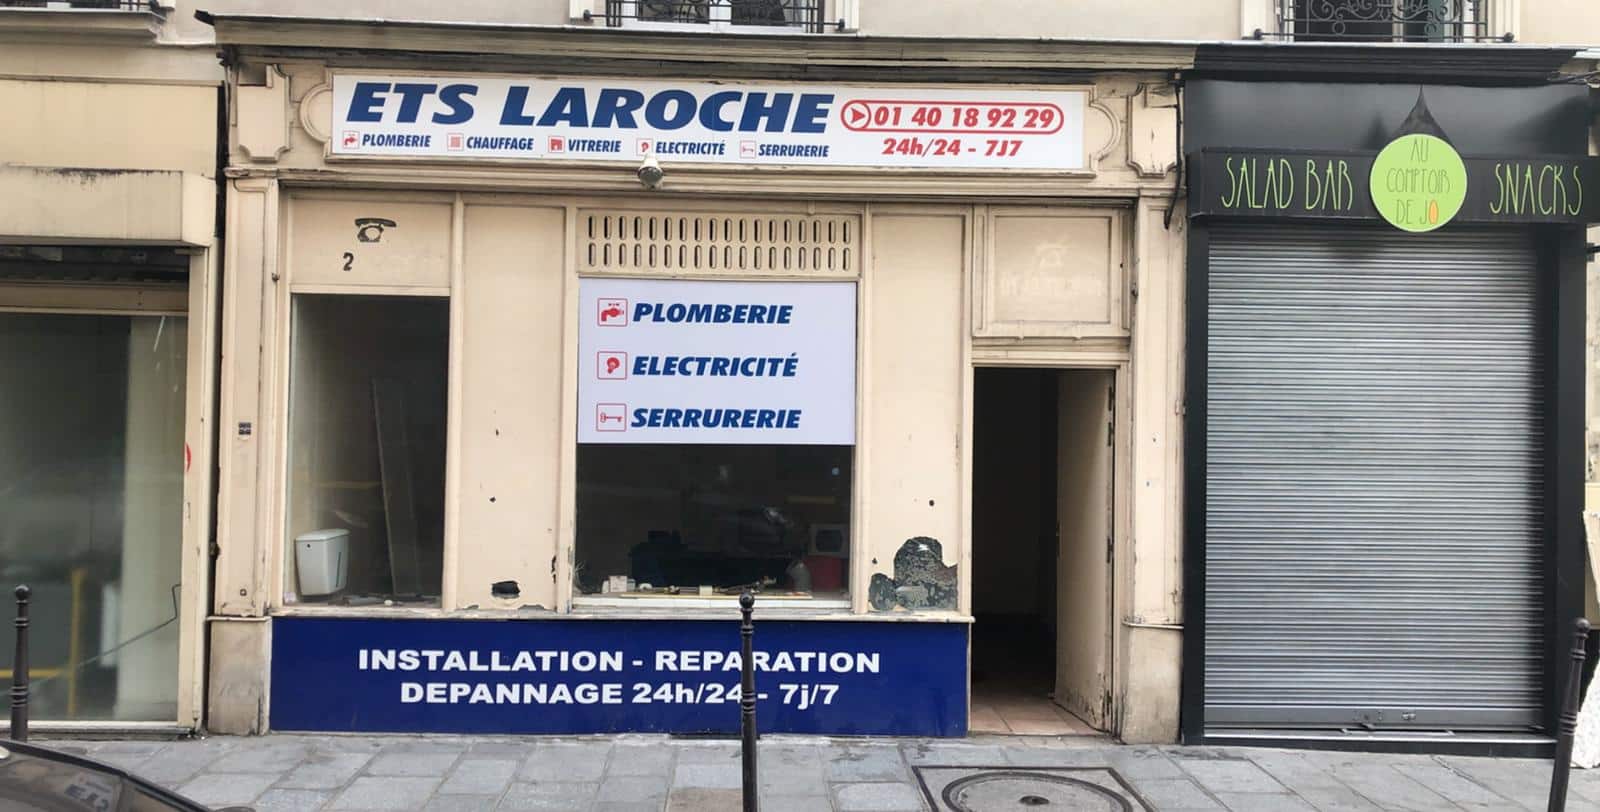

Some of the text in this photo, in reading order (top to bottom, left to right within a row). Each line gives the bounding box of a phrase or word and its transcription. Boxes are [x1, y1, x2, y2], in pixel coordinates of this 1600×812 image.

[346, 82, 835, 133] ETS LAROCHE
[874, 107, 1054, 128] 01 40 18 92 29
[362, 133, 432, 148] PLOMBERIE
[466, 136, 534, 151] CHAUFFAGE
[568, 139, 621, 153] VITRERIE
[655, 139, 726, 155] ELECTRICITÉ
[758, 144, 829, 158] SERRURERIE
[882, 138, 961, 157] 24h/24
[986, 140, 1023, 157] 7J7
[1410, 137, 1429, 162] AU
[1222, 158, 1353, 211] SALAD BAR
[1386, 167, 1451, 194] COMPTOIR
[1489, 163, 1583, 217] SNACKS
[1396, 199, 1439, 225] DE JO
[343, 252, 354, 272] 2
[633, 303, 793, 324] PLOMBERIE
[632, 352, 799, 377] ELECTRICITÉ
[631, 408, 802, 429] SERRURERIE
[359, 649, 623, 672] INSTALLATION
[655, 650, 880, 673] REPARATION
[401, 683, 623, 704] DEPANNAGE
[632, 683, 742, 704] 24h/24
[779, 684, 839, 710] 7j/7
